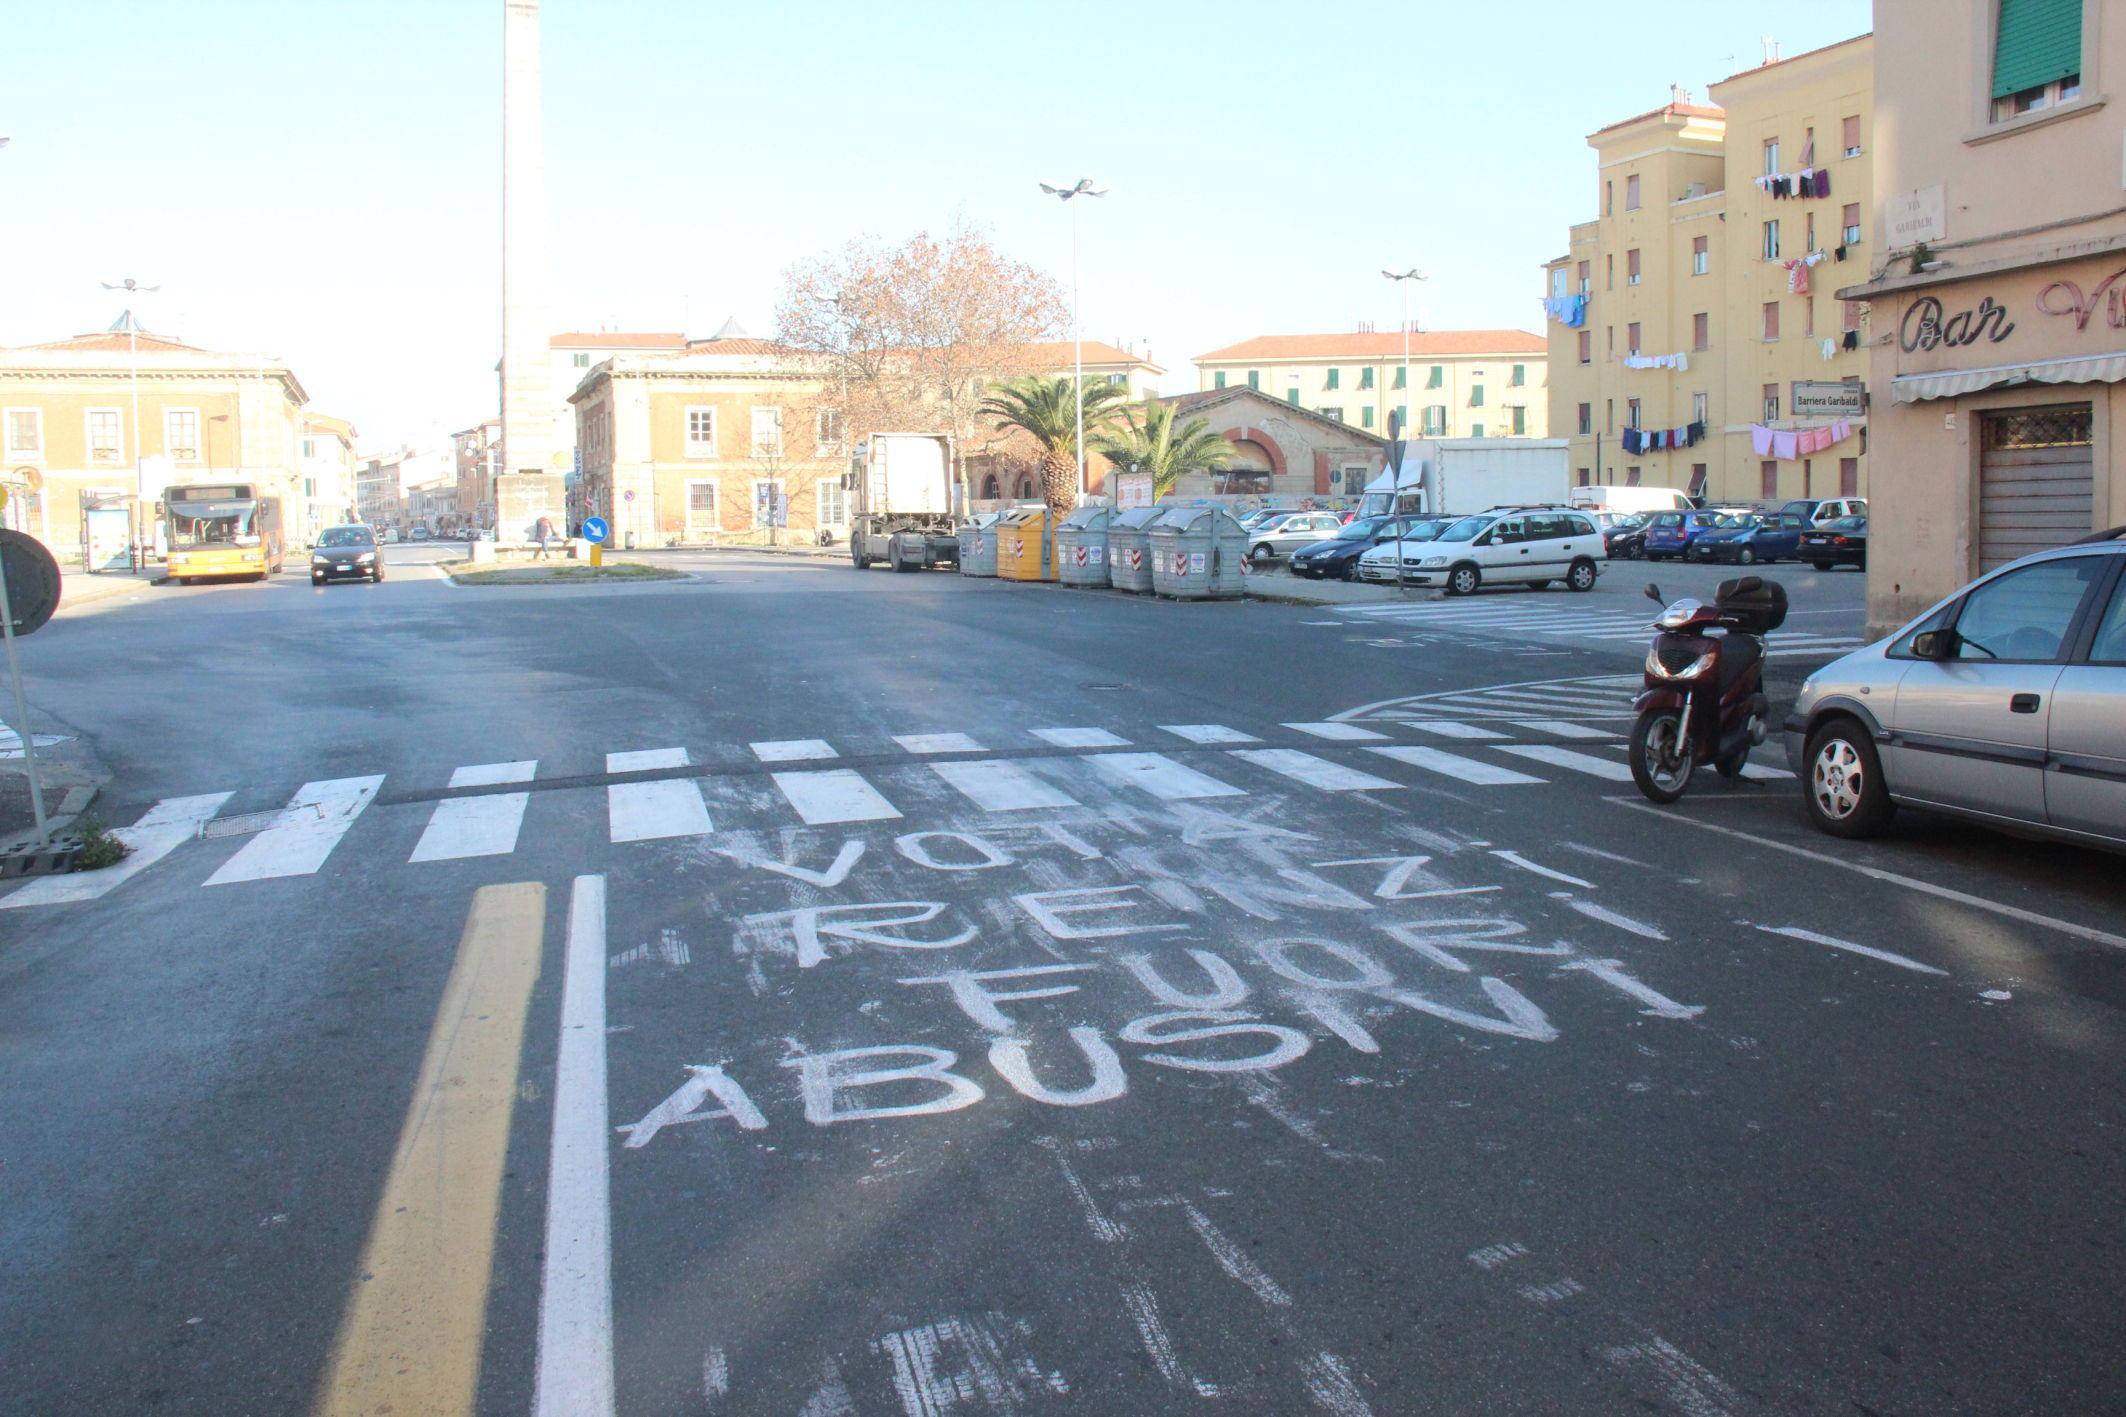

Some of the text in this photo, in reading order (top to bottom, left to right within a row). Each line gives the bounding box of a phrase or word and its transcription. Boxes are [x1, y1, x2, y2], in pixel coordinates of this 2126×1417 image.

[1901, 296, 2016, 353] Bar
[1798, 395, 1858, 406] Barriera Garibaldi
[710, 800, 1322, 888] VOTA
[742, 849, 1598, 968] RENZI
[897, 892, 1671, 1034] FUORI
[614, 957, 1707, 1148] ABUSIVI
